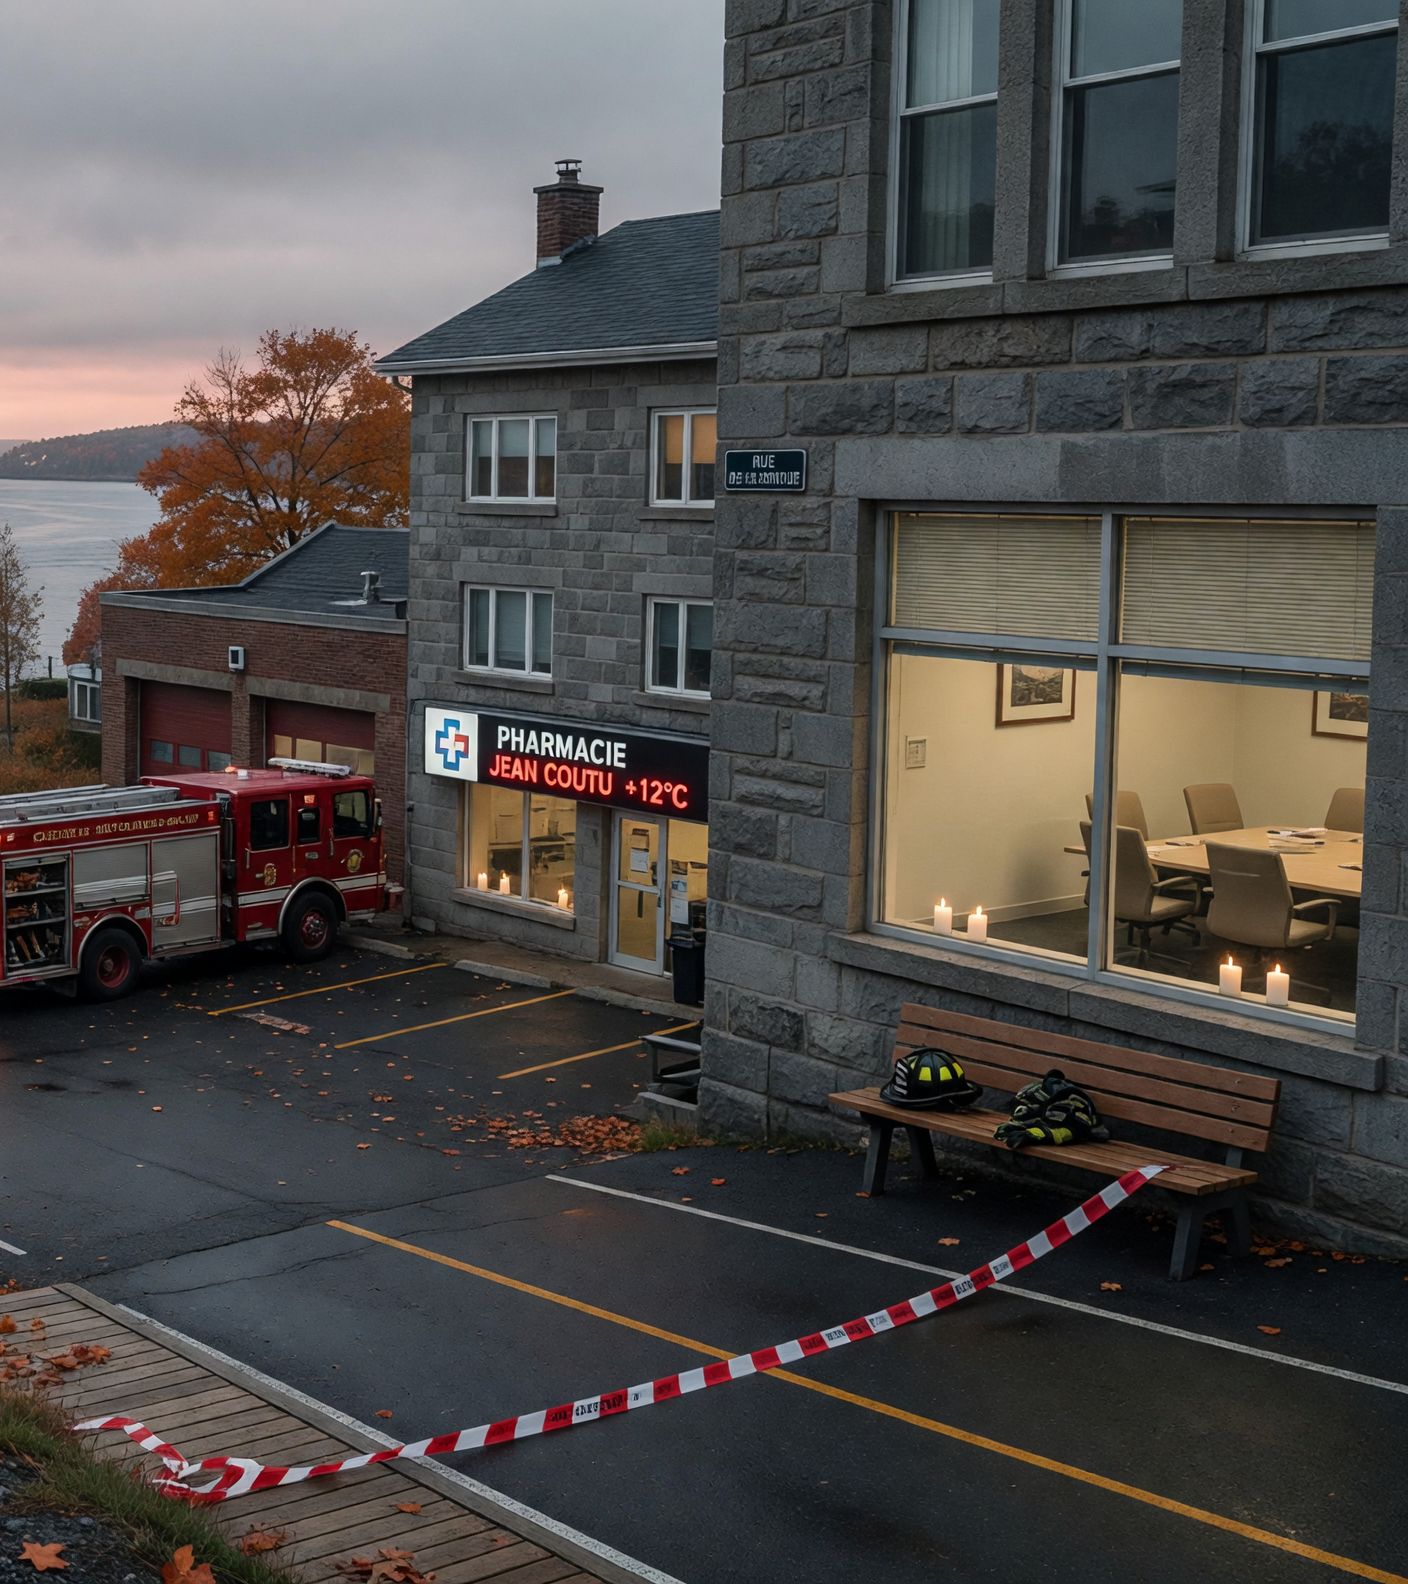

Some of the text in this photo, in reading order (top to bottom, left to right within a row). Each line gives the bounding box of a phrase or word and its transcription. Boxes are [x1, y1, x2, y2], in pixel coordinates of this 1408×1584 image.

[752, 454, 776, 469] RUE
[497, 725, 627, 769] PHARMACIE
[489, 754, 689, 809] JEAN COUTU +12°C
